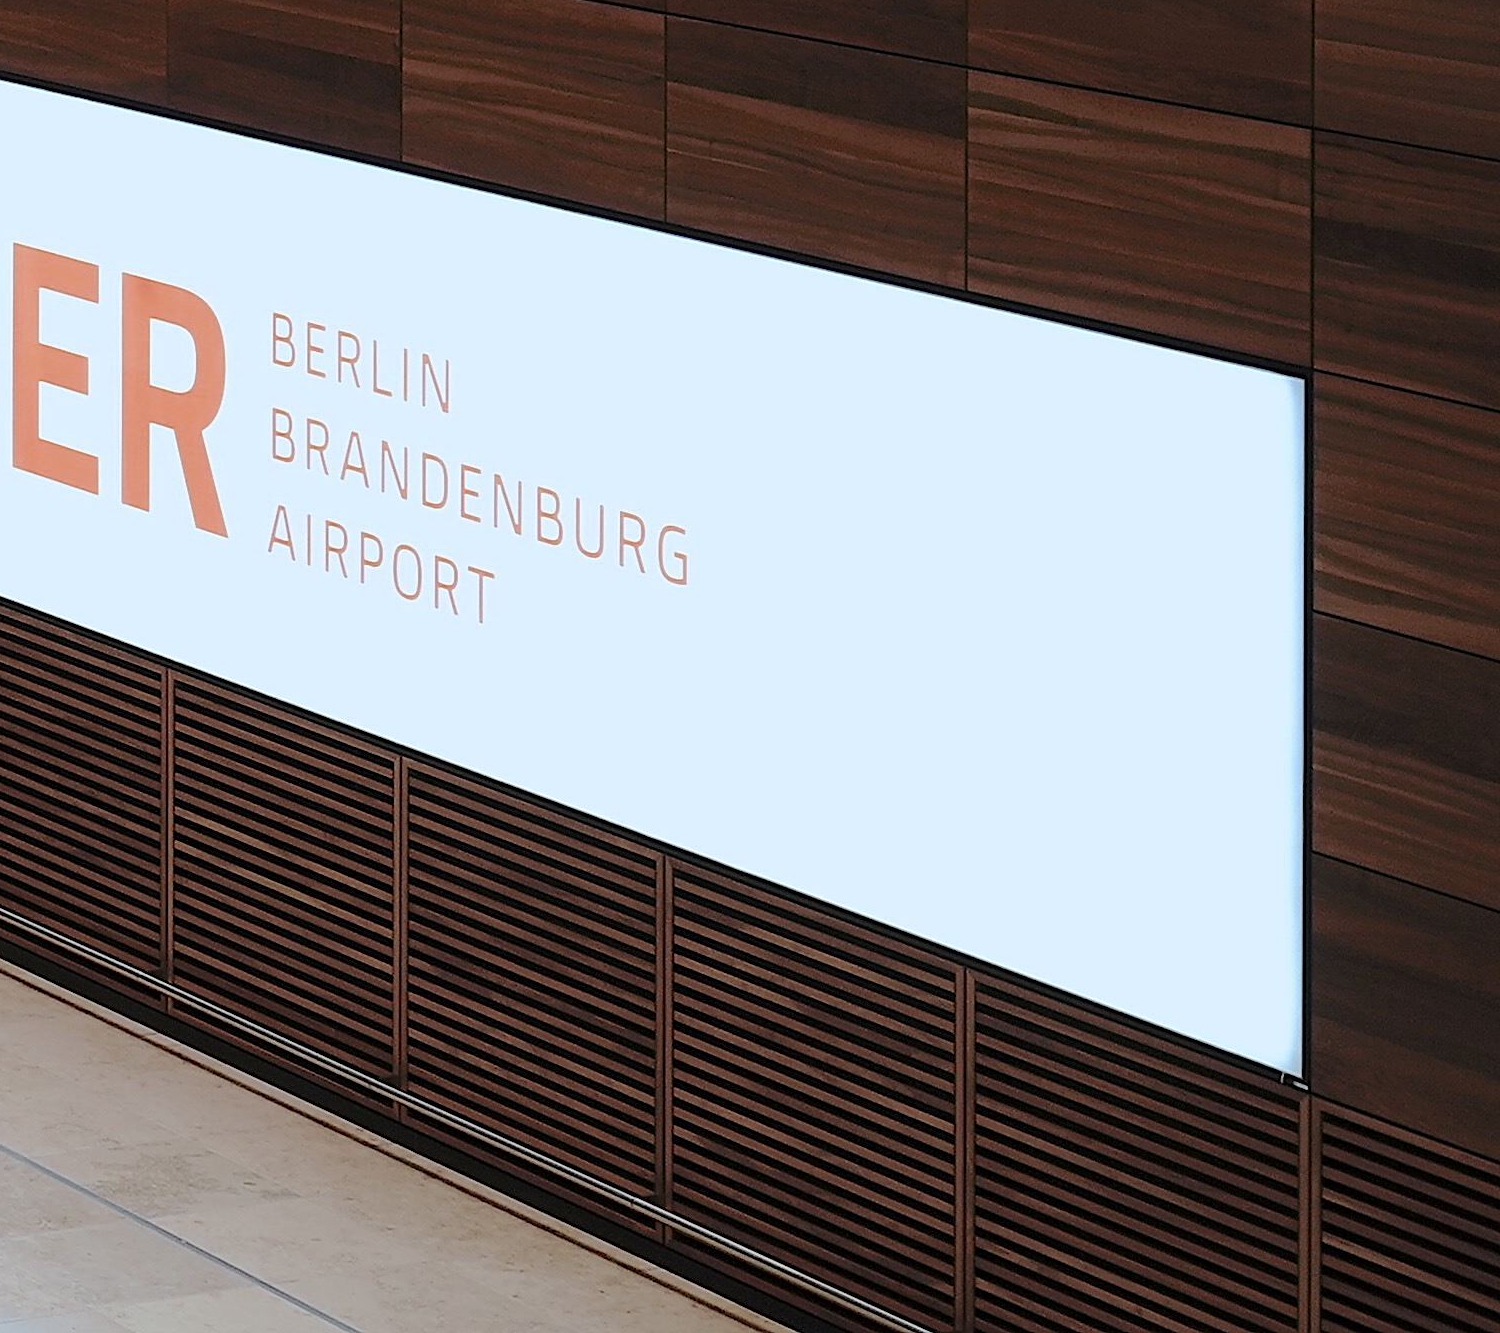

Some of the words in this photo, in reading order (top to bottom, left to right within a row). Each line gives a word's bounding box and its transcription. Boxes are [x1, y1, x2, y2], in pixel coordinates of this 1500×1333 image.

[269, 310, 452, 415] BERLIN
[268, 405, 690, 588] BRANDENBURG
[267, 502, 497, 624] AIRPORT
